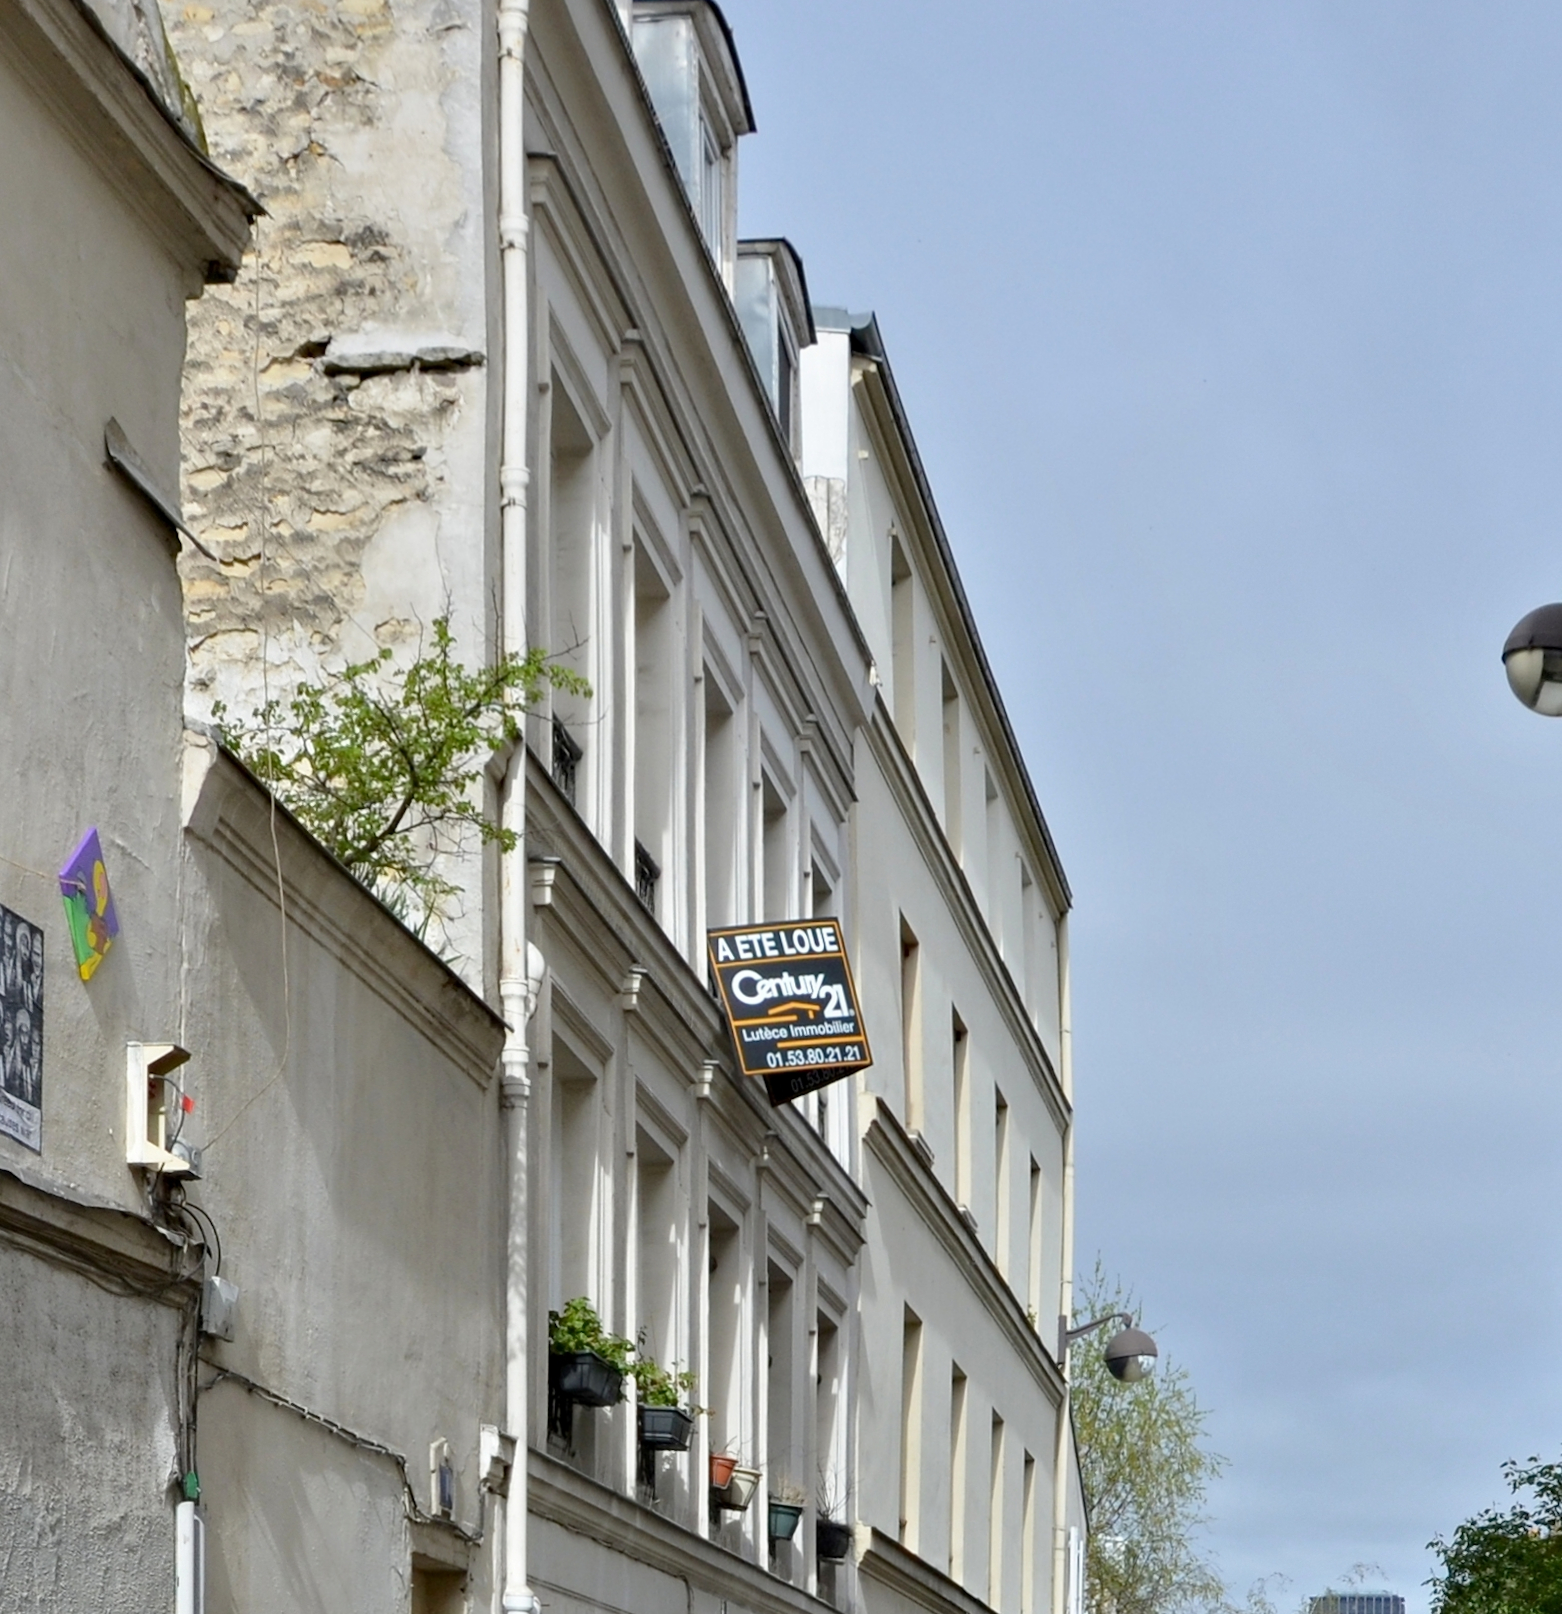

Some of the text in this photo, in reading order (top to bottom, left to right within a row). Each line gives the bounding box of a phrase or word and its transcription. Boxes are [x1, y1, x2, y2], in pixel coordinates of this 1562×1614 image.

[717, 926, 839, 962] A ETE LOUE
[731, 969, 825, 1005] Century
[742, 1020, 856, 1043] Lutèce Immobilier
[766, 1045, 861, 1068] 01.53.80.21.21
